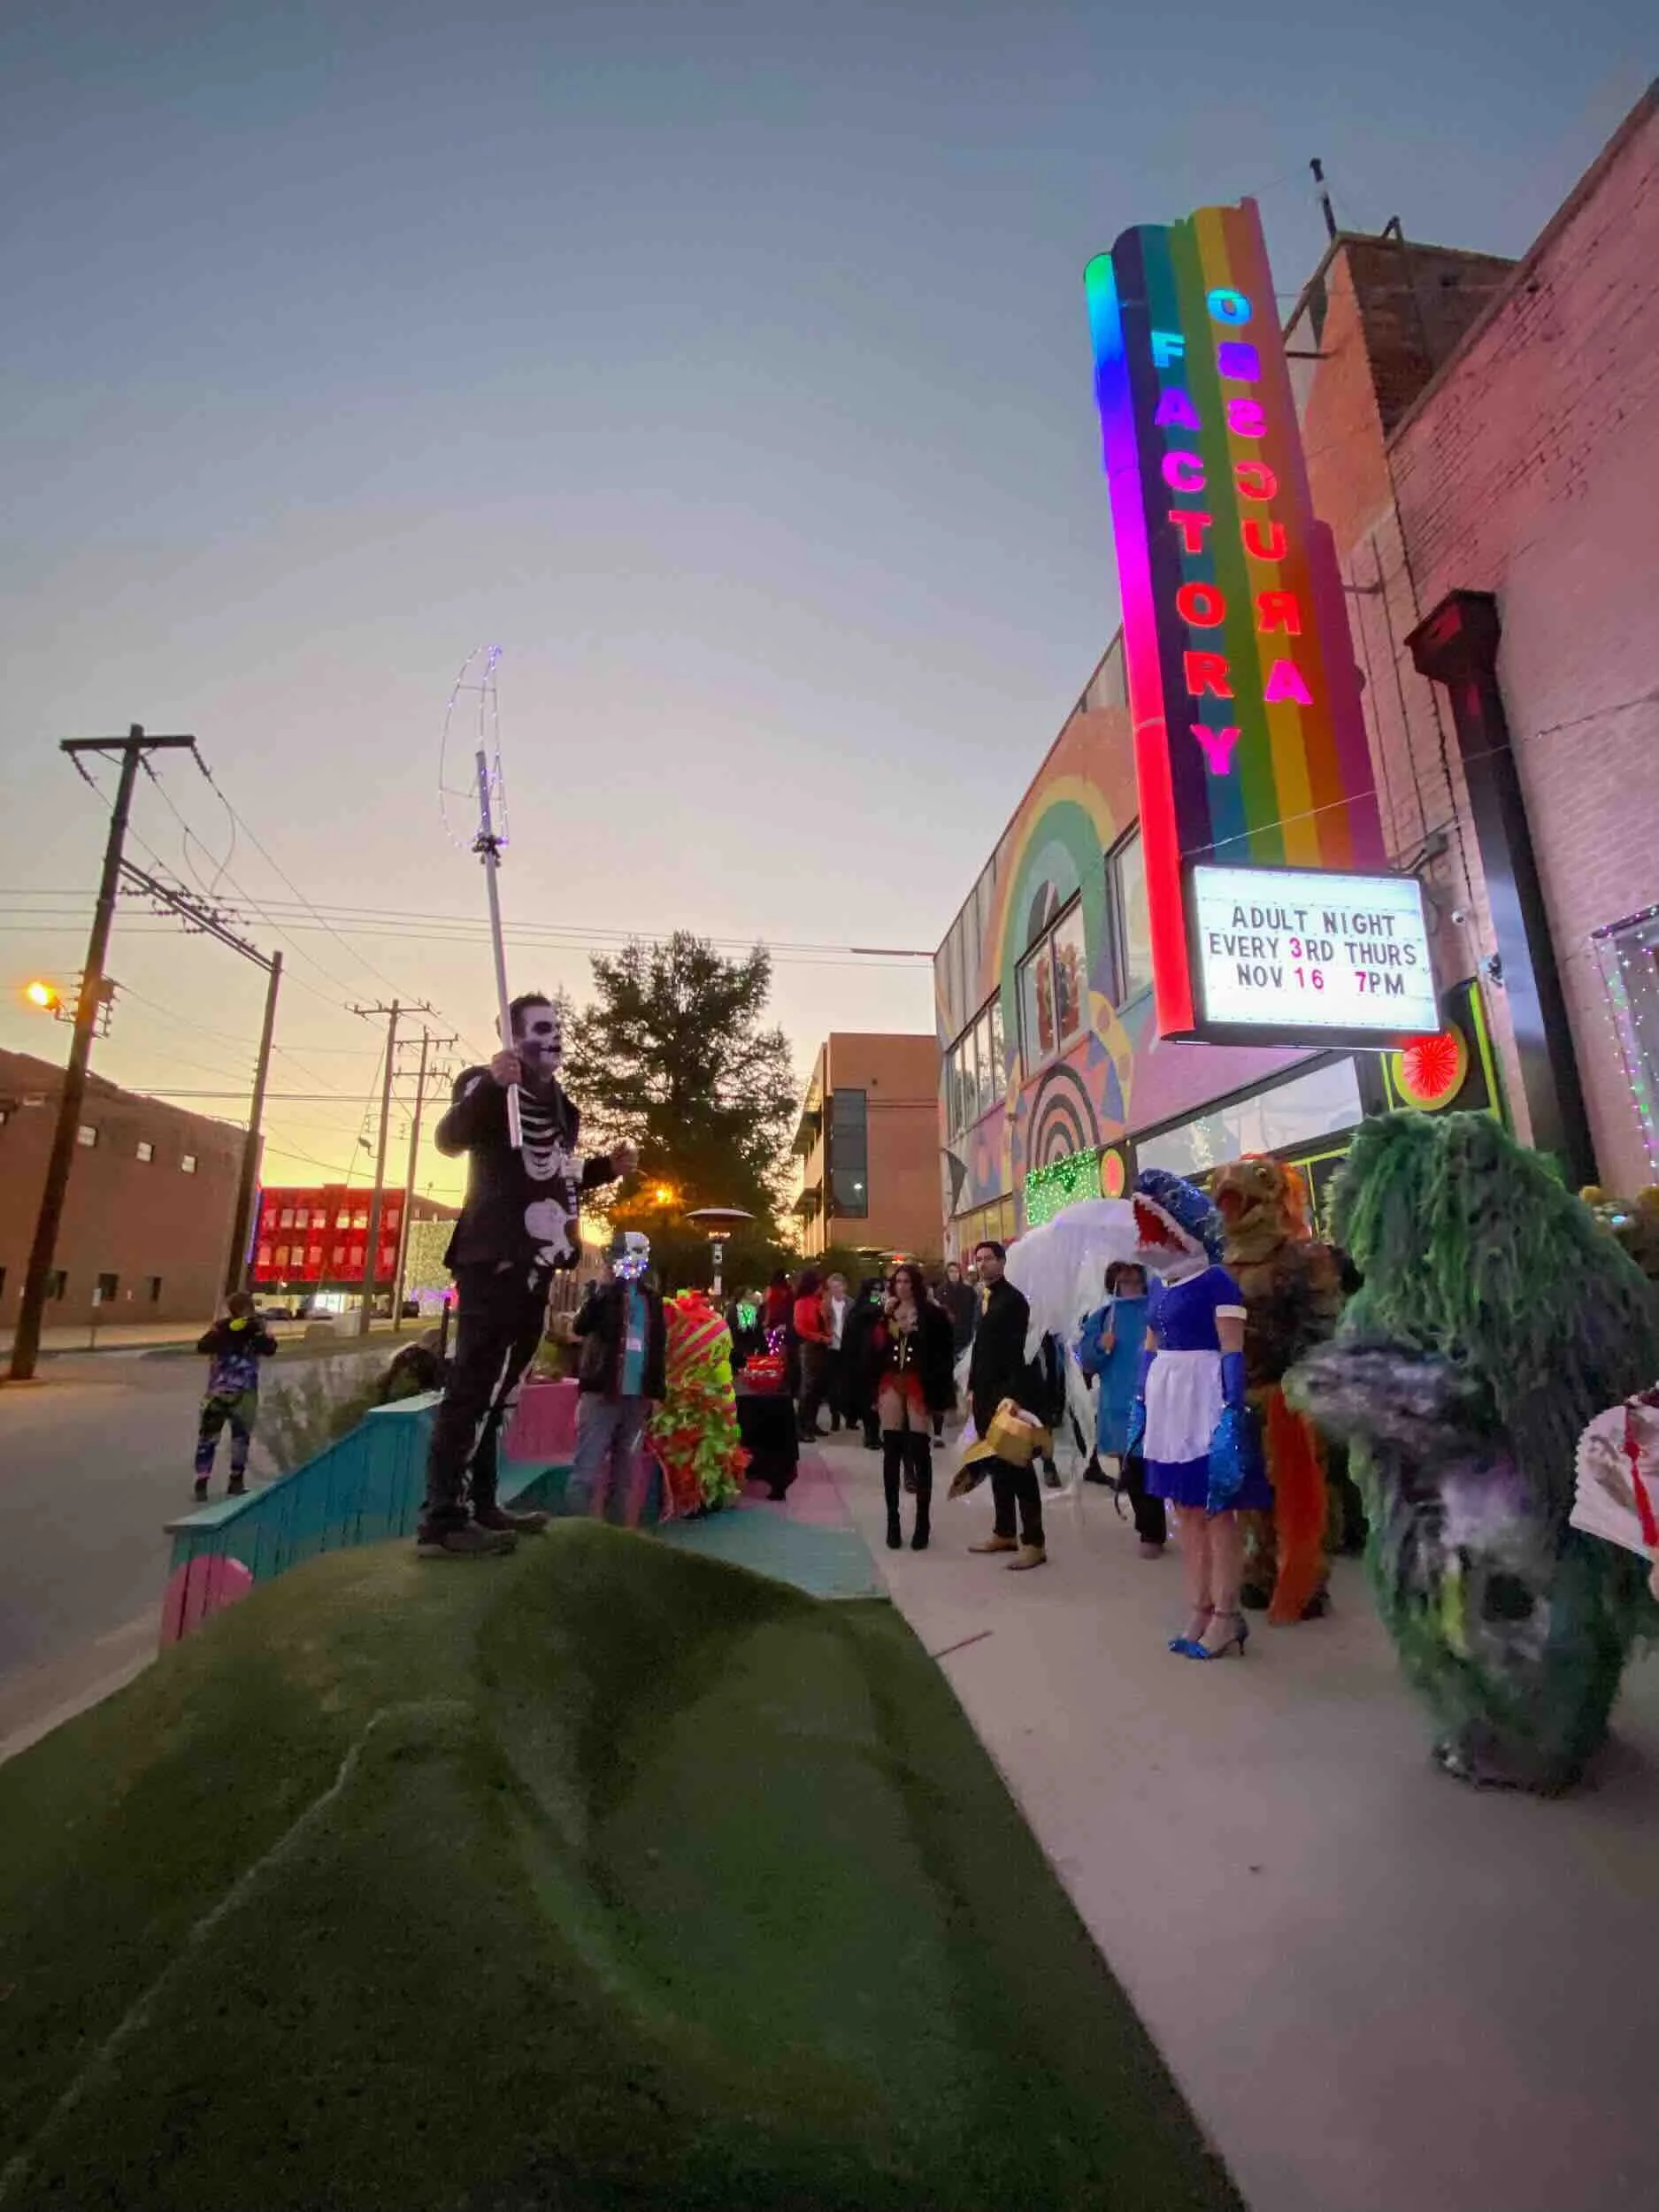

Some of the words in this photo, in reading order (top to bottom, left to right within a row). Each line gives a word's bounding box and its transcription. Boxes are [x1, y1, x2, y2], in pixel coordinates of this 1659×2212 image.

[1151, 329, 1242, 775] FACTORY
[1232, 905, 1308, 932] ADULT
[1323, 911, 1395, 937] NIGHT
[1209, 933, 1279, 959] EVERY
[1289, 937, 1334, 963] 3RD
[1344, 941, 1417, 966] THURS
[1236, 963, 1282, 988] NOV
[1294, 966, 1325, 990] 16
[1355, 972, 1405, 995] 7PM
